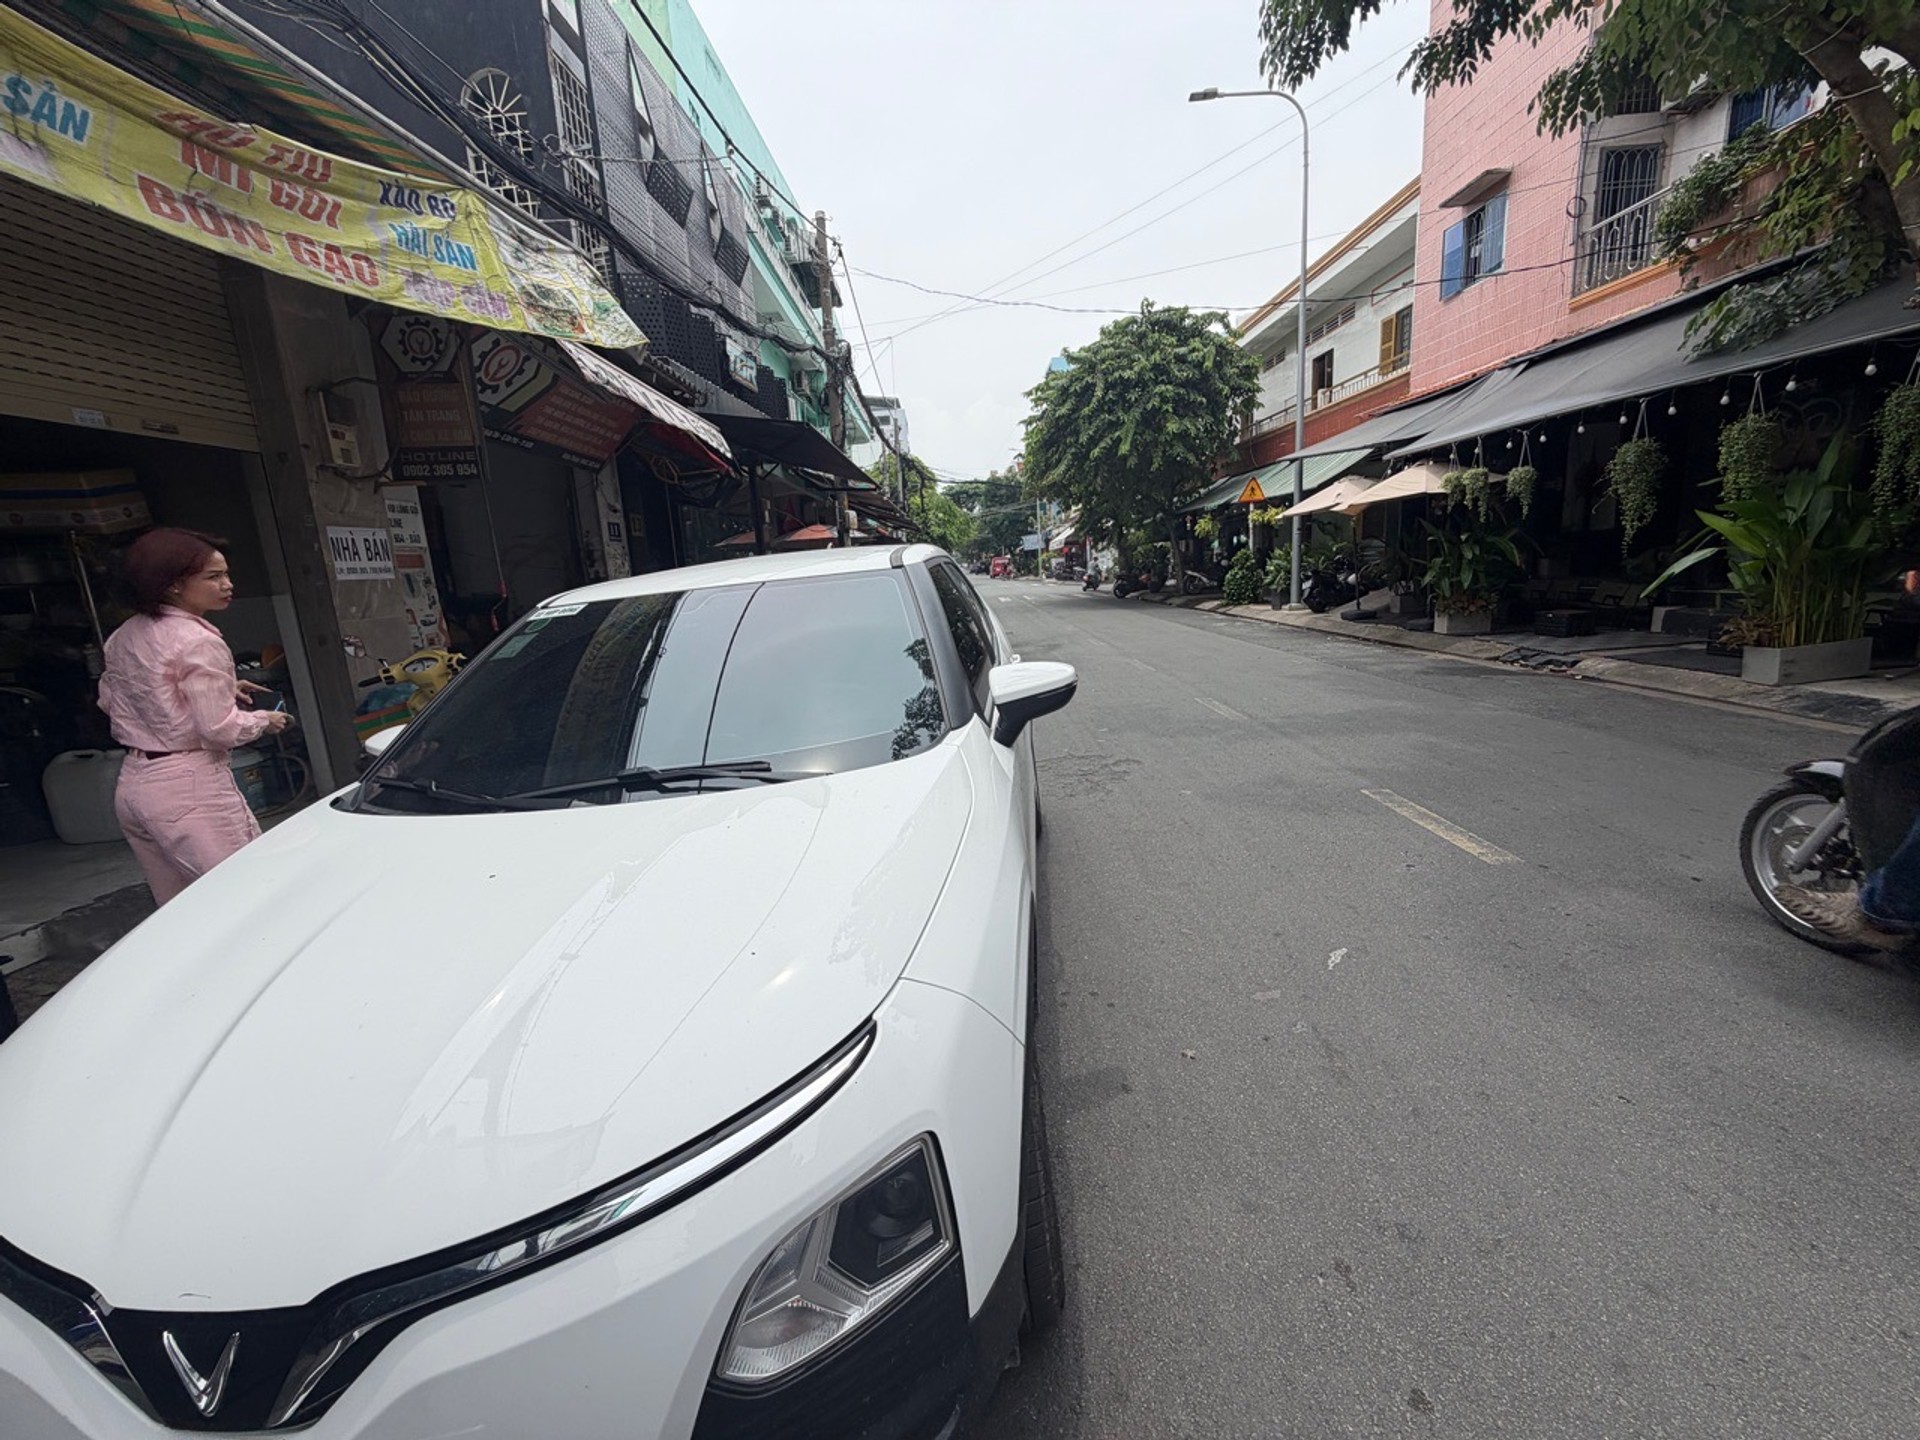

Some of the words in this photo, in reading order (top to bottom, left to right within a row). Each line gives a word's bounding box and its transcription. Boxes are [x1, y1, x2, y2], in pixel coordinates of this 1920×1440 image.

[285, 232, 380, 287] GẠO
[434, 230, 478, 271] SẢN
[400, 451, 477, 461] HOTLINE
[402, 464, 430, 477] 0902
[330, 530, 361, 562] NHÀ
[363, 531, 391, 562] BÁN
